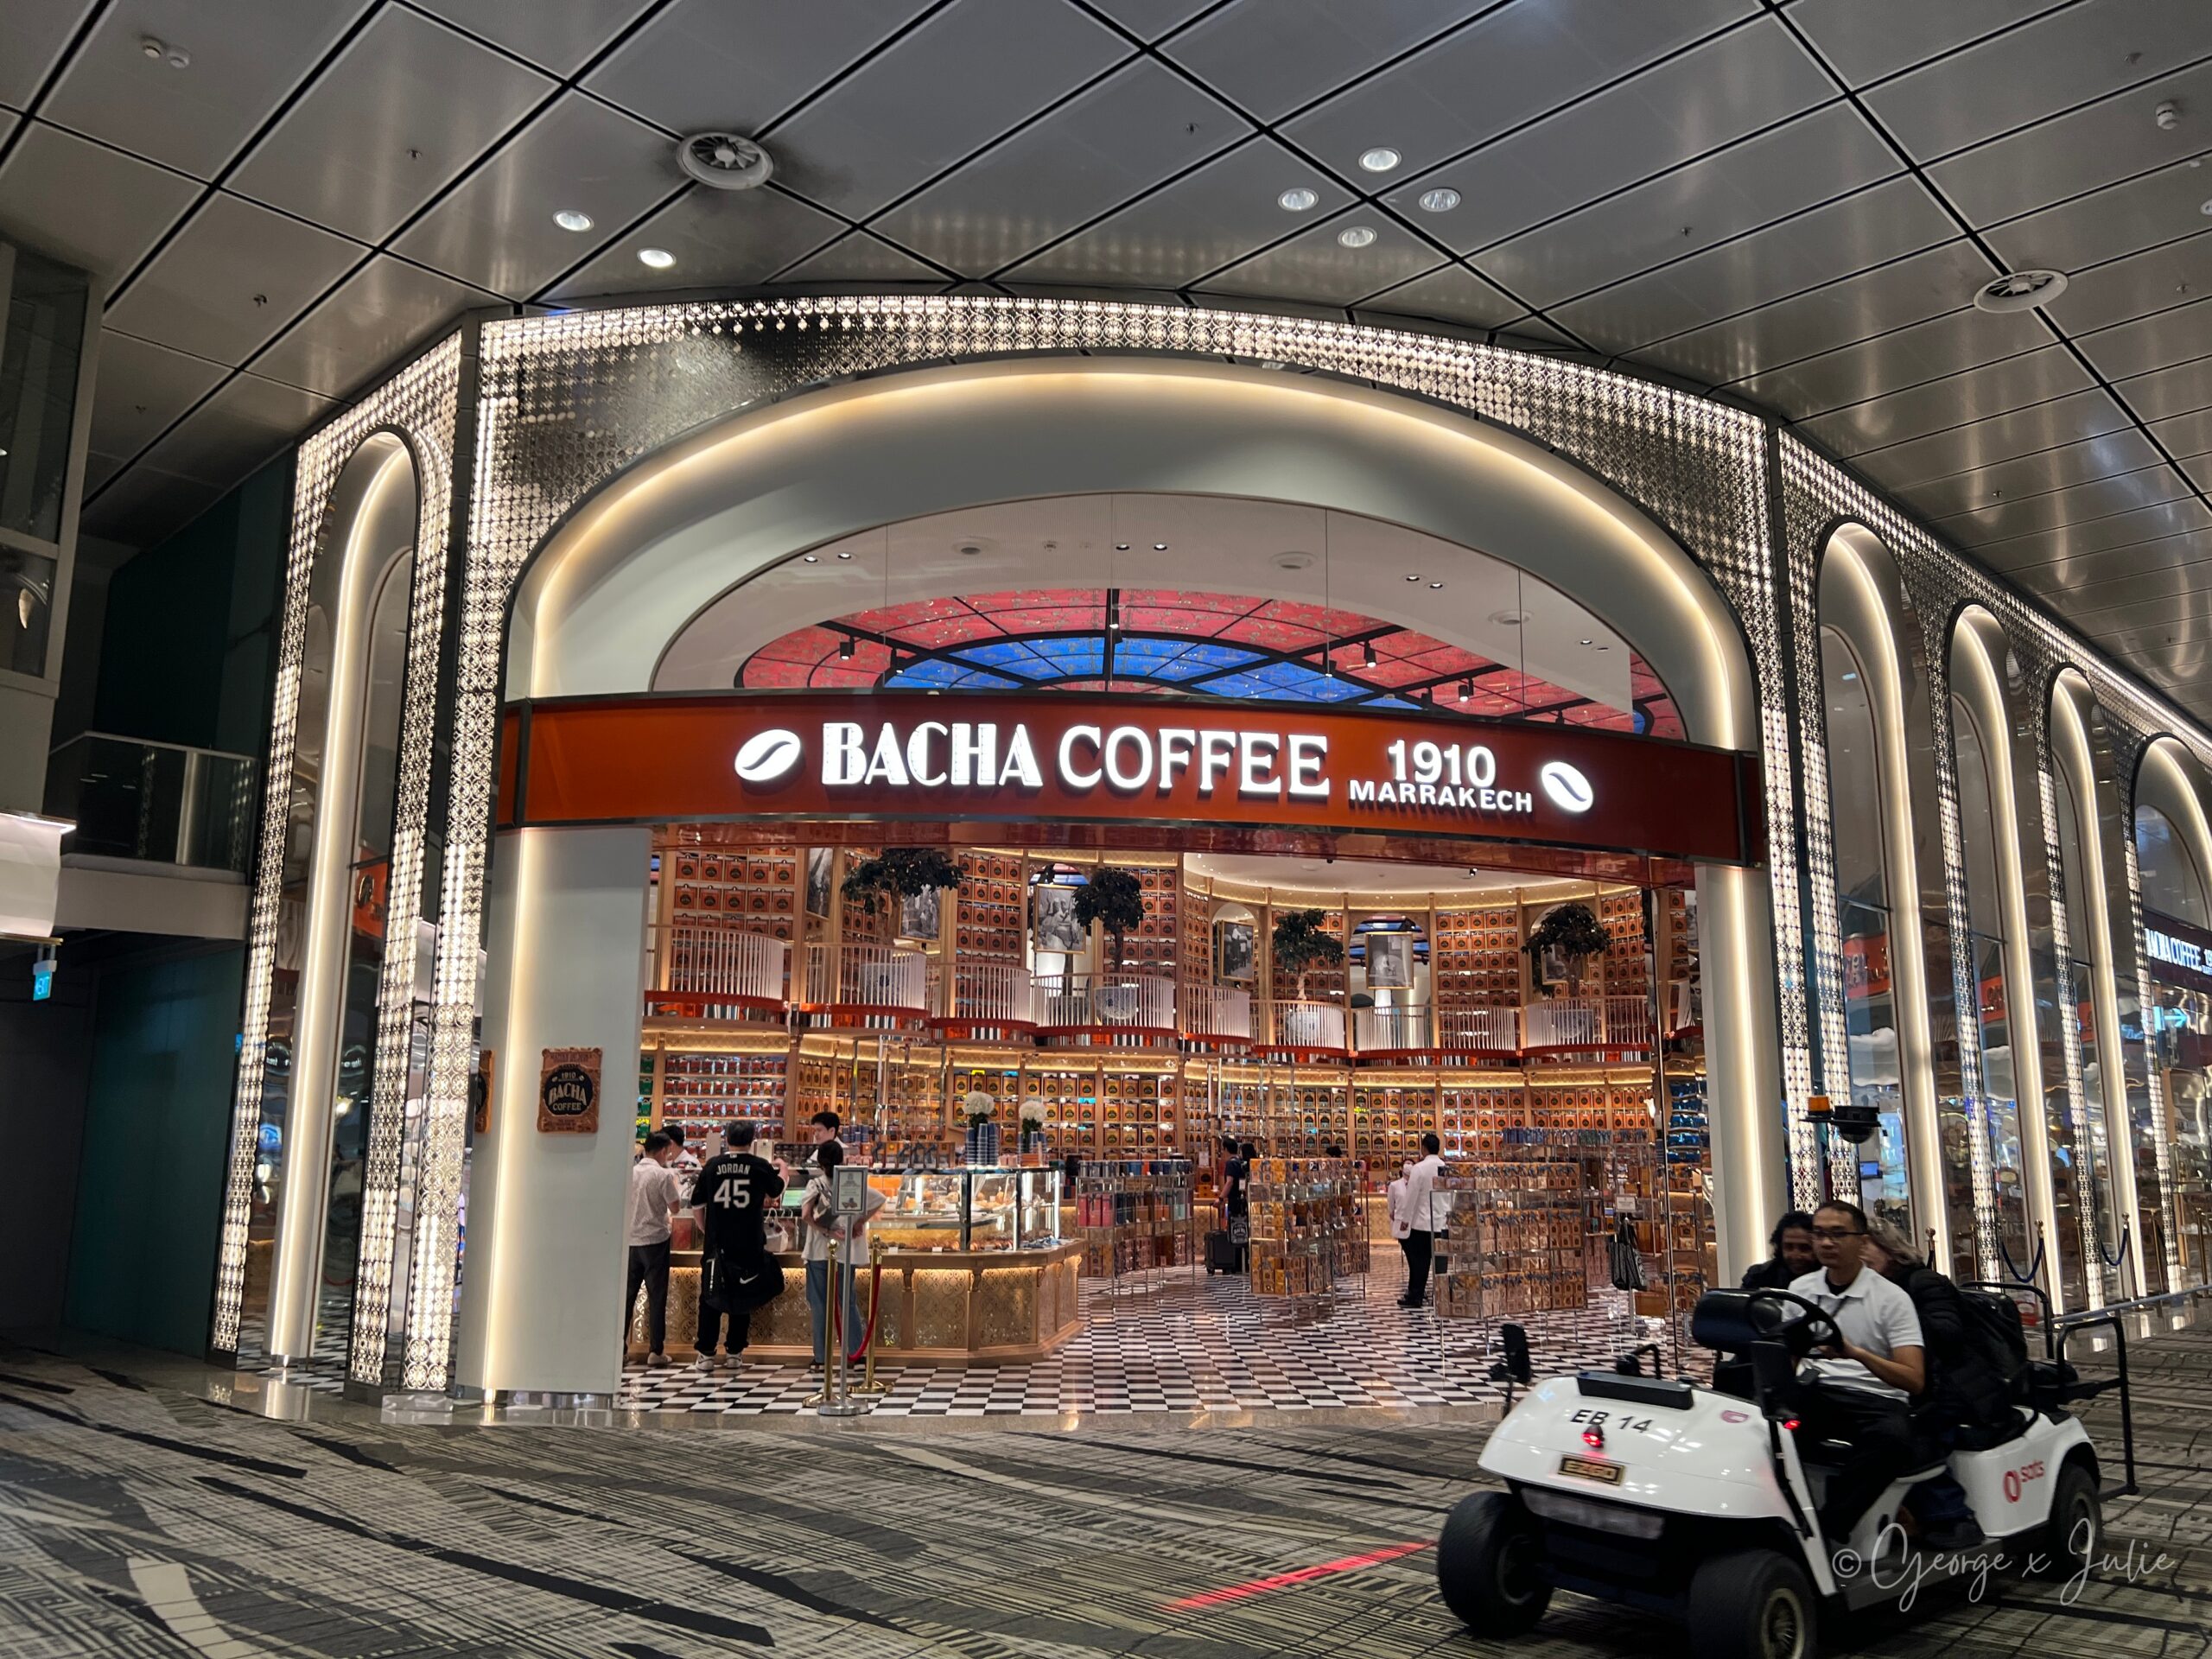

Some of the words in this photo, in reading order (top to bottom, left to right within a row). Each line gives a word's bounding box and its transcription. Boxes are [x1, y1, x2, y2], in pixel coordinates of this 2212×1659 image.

[821, 722, 1044, 788] BACHA
[1058, 725, 1331, 798] COFFEE
[1388, 739, 1497, 788] 1910
[1349, 779, 1533, 814] MARRAKECH
[549, 1084, 587, 1106] BACHA
[552, 1102, 582, 1111] COFFEE
[716, 1163, 751, 1175] JORDAN
[713, 1179, 751, 1209] 45
[1570, 1408, 1610, 1426] EB
[1618, 1415, 1654, 1433] 14
